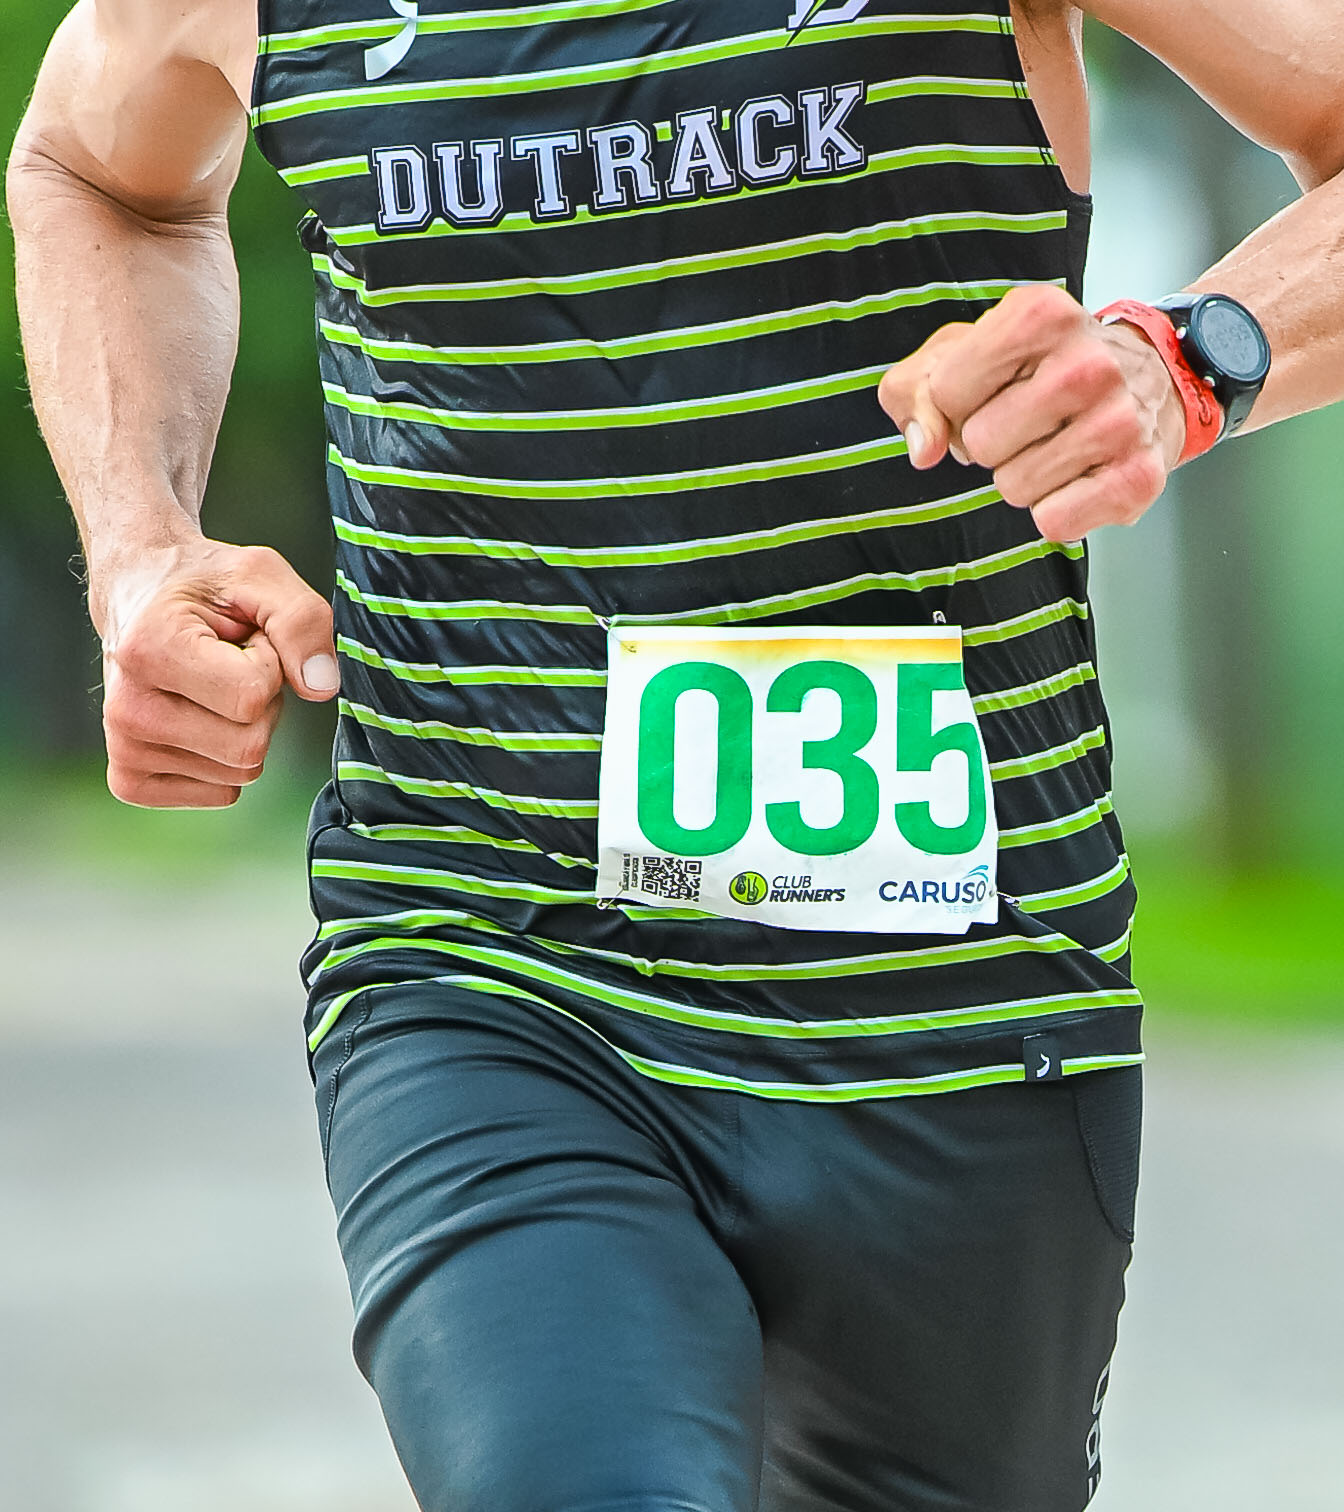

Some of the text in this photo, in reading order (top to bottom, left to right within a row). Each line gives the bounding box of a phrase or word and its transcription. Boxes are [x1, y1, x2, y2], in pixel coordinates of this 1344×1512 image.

[372, 80, 867, 232] DUTRACK
[637, 660, 988, 857] 035
[772, 875, 811, 888] CLUB
[878, 880, 987, 904] CARUSO
[769, 888, 846, 903] RUNNER'S
